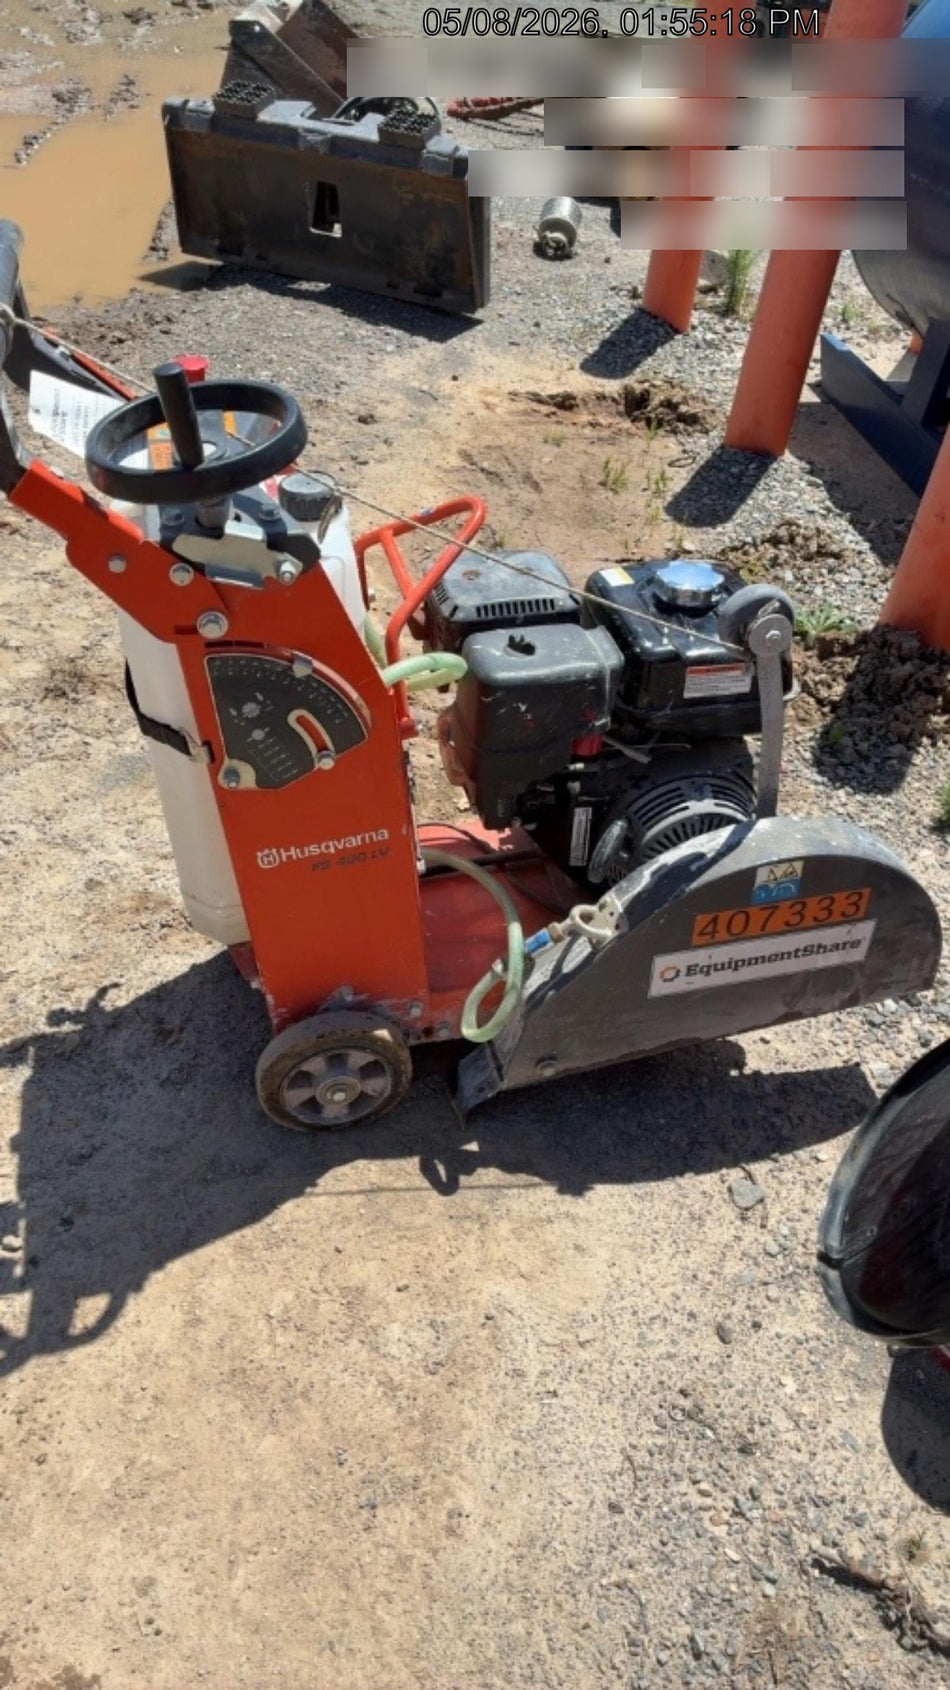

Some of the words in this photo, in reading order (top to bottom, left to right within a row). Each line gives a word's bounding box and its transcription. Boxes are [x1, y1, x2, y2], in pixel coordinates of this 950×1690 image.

[281, 828, 390, 862] Husqvarna
[697, 891, 864, 941] 407333
[684, 938, 863, 978] EquipmentShare
